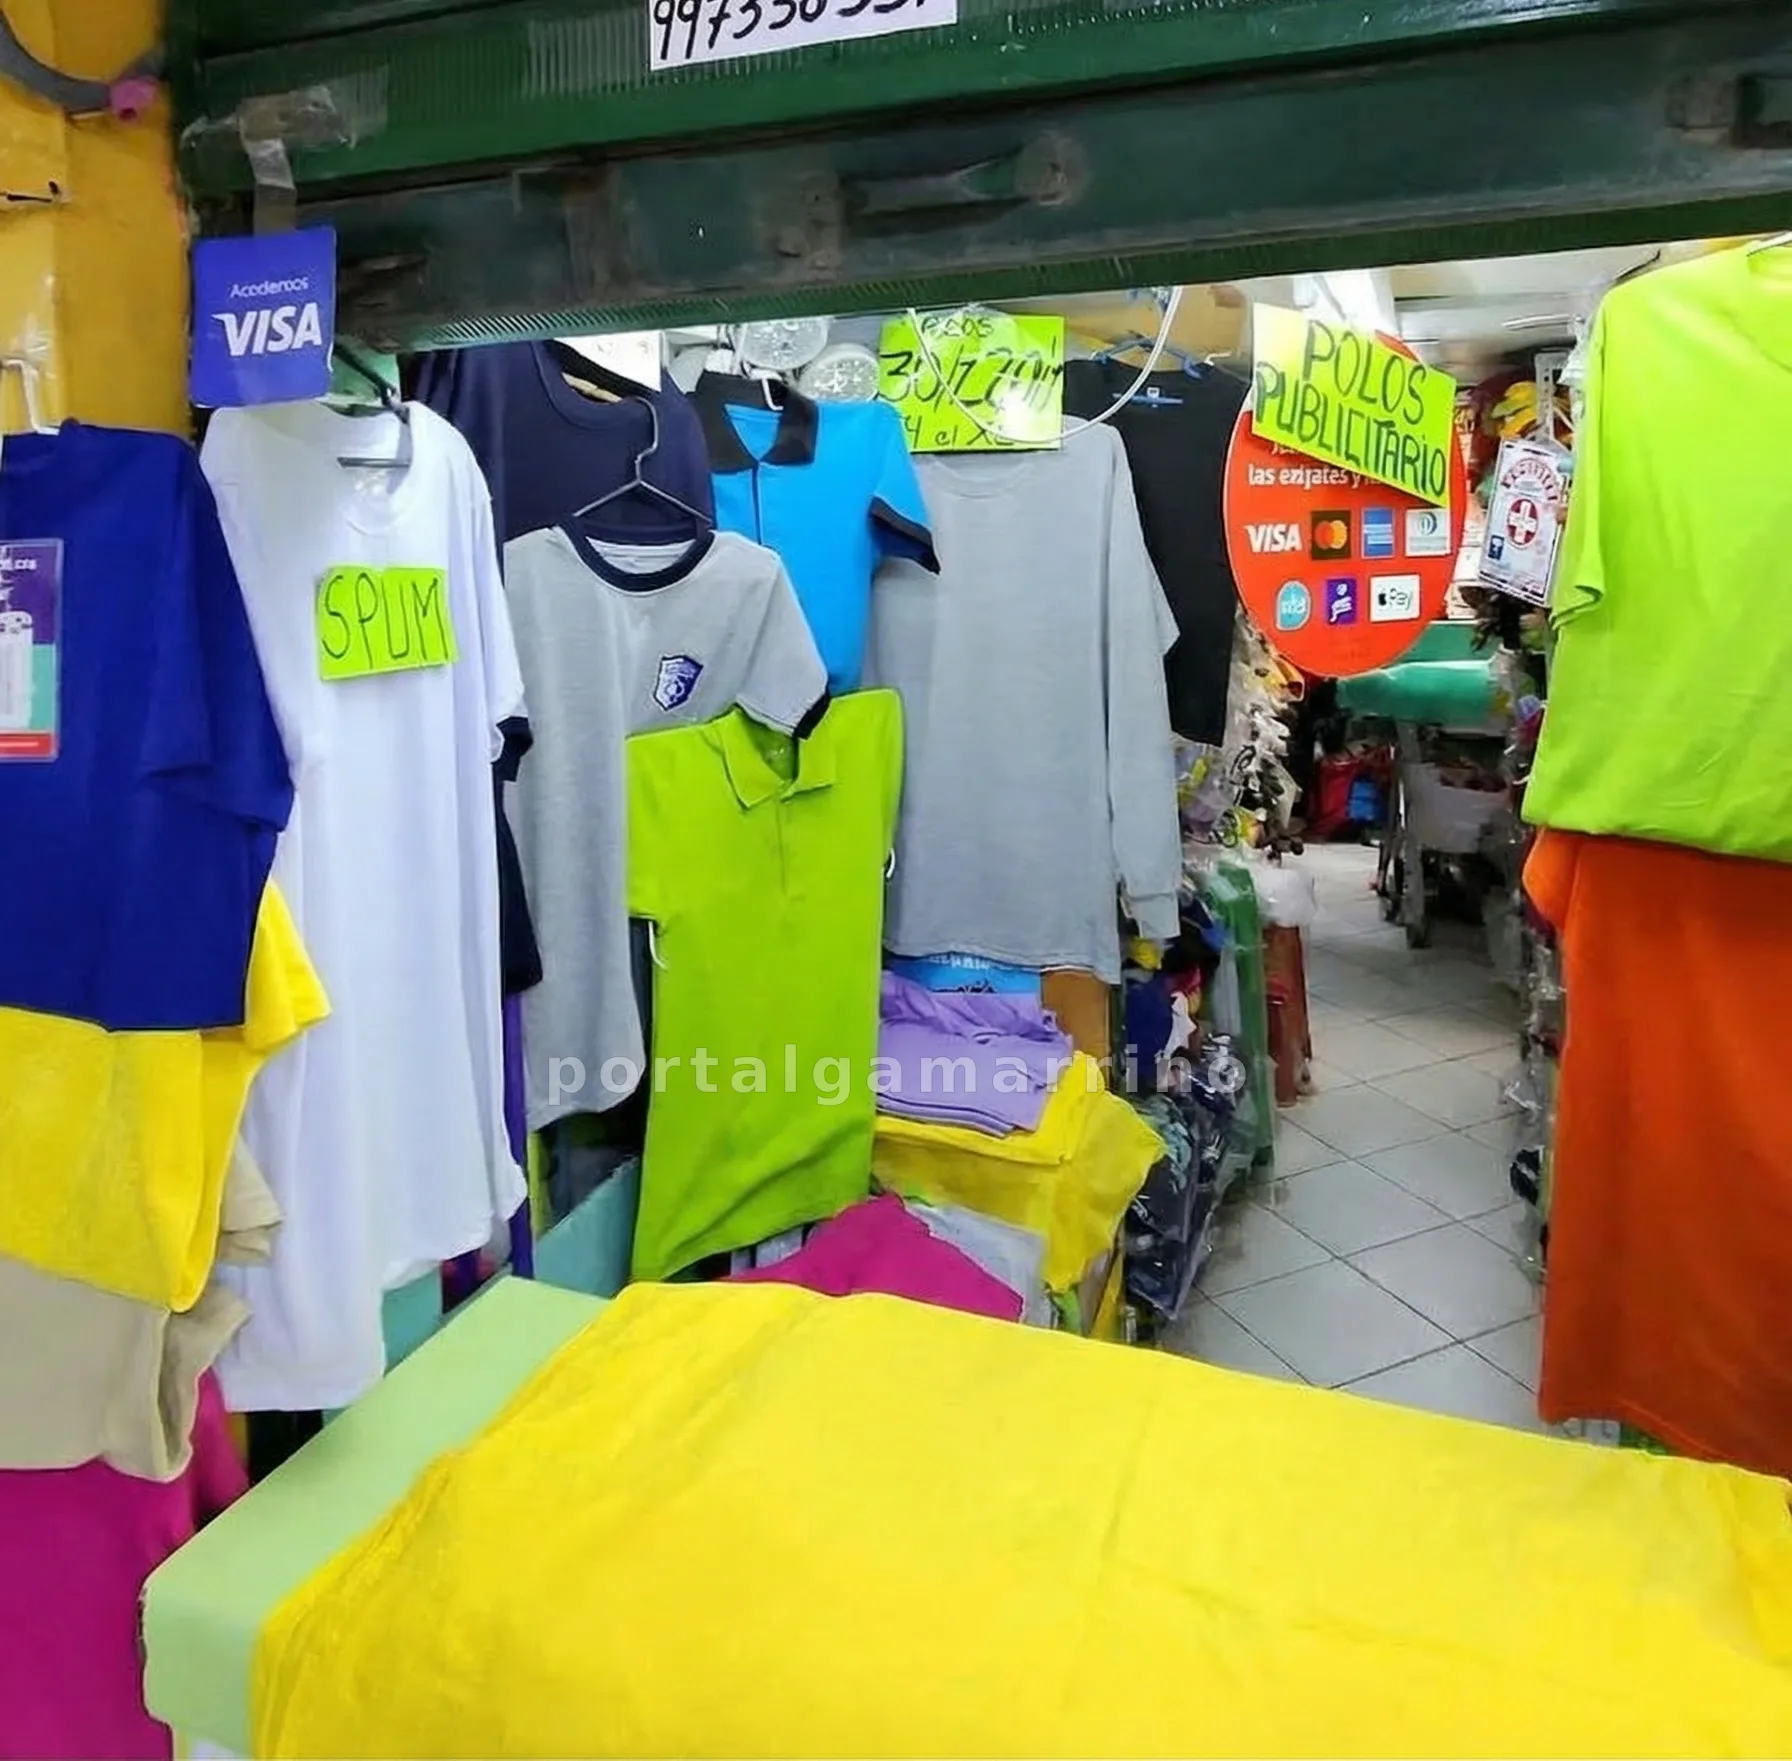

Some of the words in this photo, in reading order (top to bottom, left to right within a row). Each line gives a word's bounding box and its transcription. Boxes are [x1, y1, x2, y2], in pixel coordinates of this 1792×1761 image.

[212, 302, 322, 357] VISA
[1302, 319, 1427, 426] POLOS
[1248, 463, 1276, 485] las
[1244, 523, 1302, 553] VISA
[322, 572, 449, 669] SPUM
